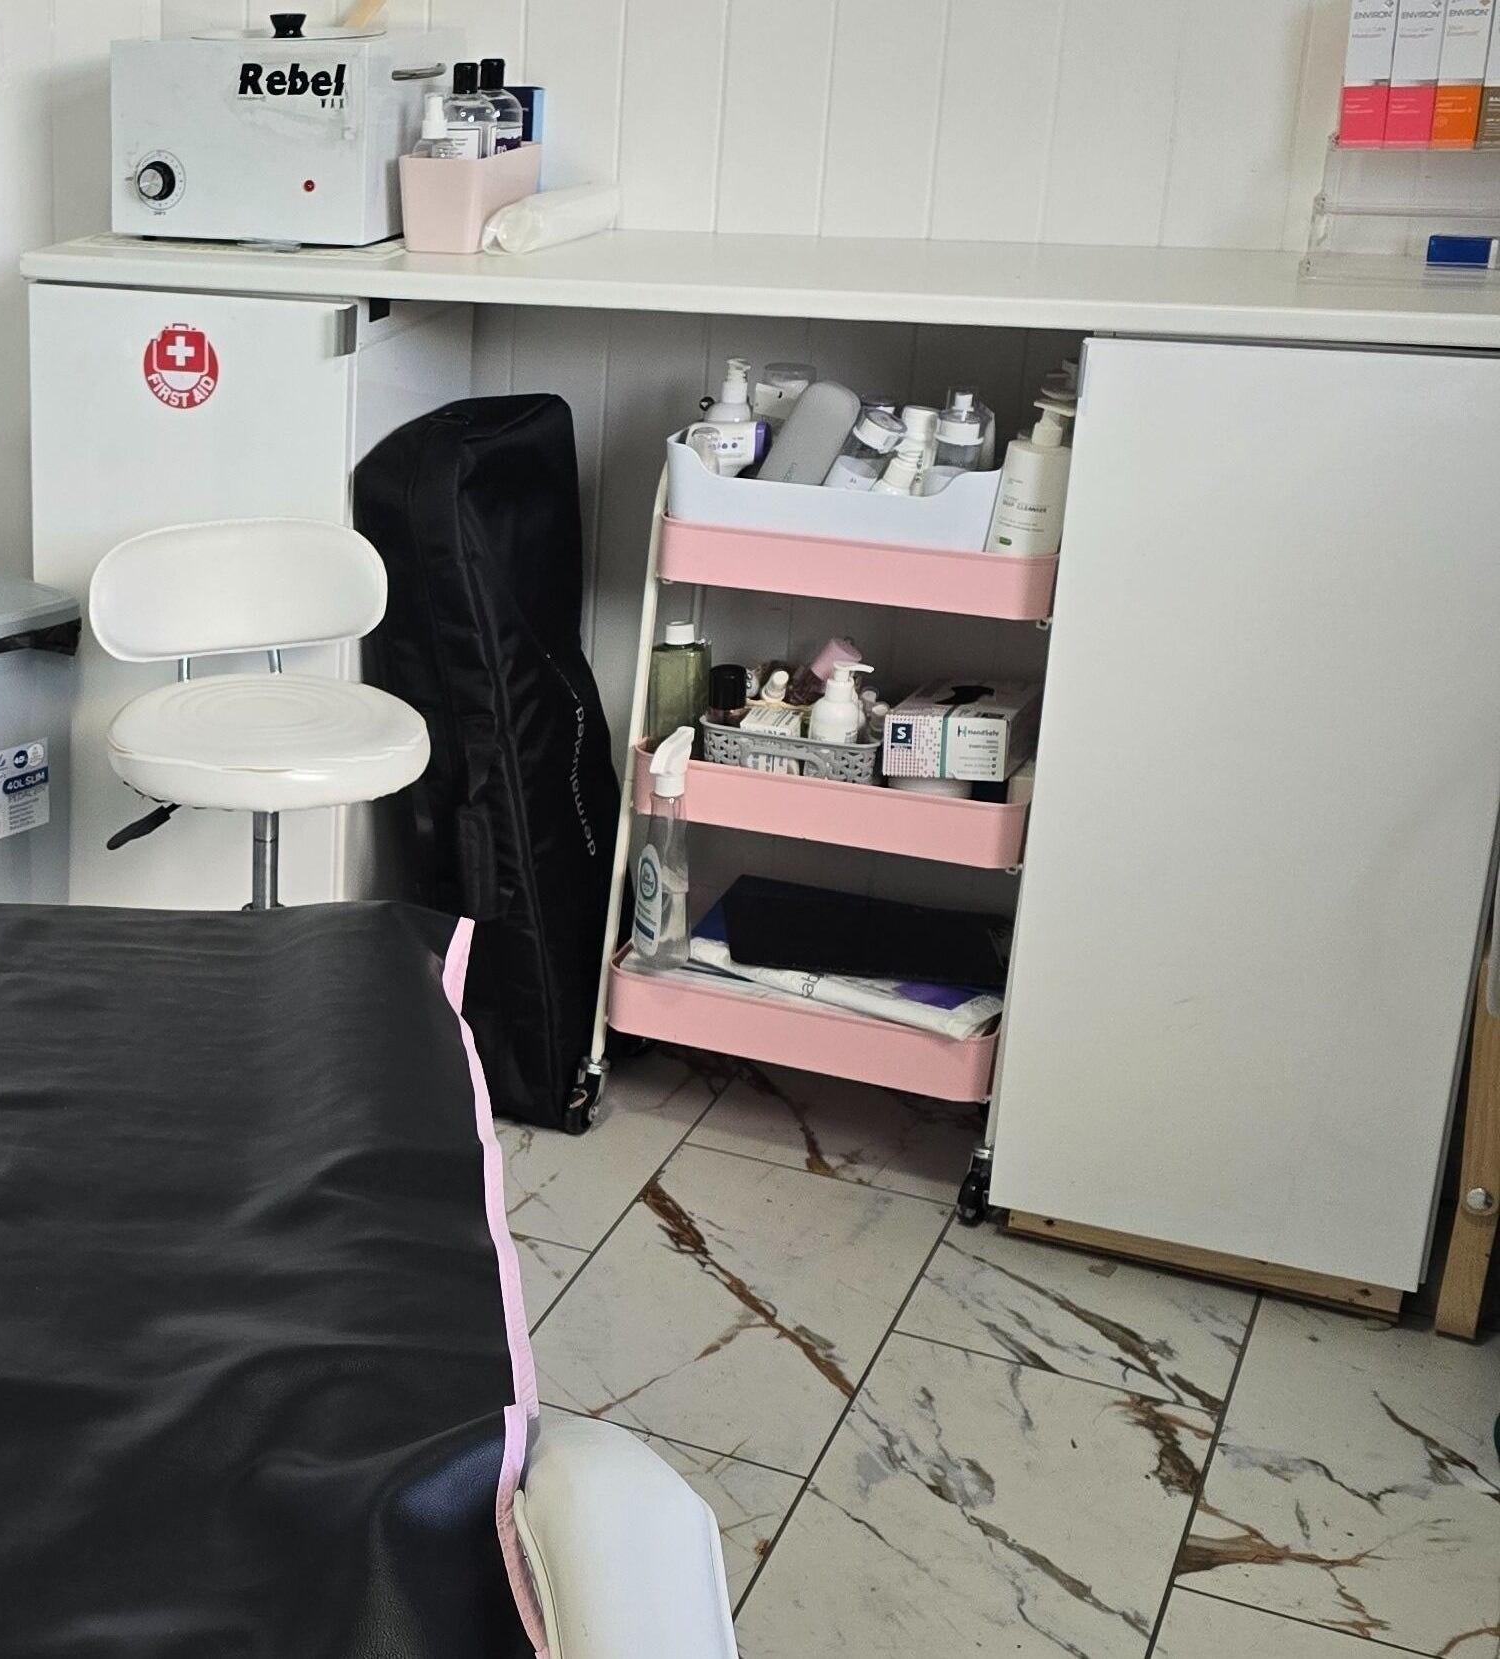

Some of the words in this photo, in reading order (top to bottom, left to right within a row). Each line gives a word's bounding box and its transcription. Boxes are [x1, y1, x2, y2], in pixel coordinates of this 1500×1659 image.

[1353, 10, 1394, 20] ENVIRON
[1400, 10, 1442, 20] ENVIRON
[1448, 8, 1489, 18] ENVIRON
[238, 63, 347, 97] Rebel
[147, 373, 190, 408] FIRST
[192, 375, 215, 404] AID
